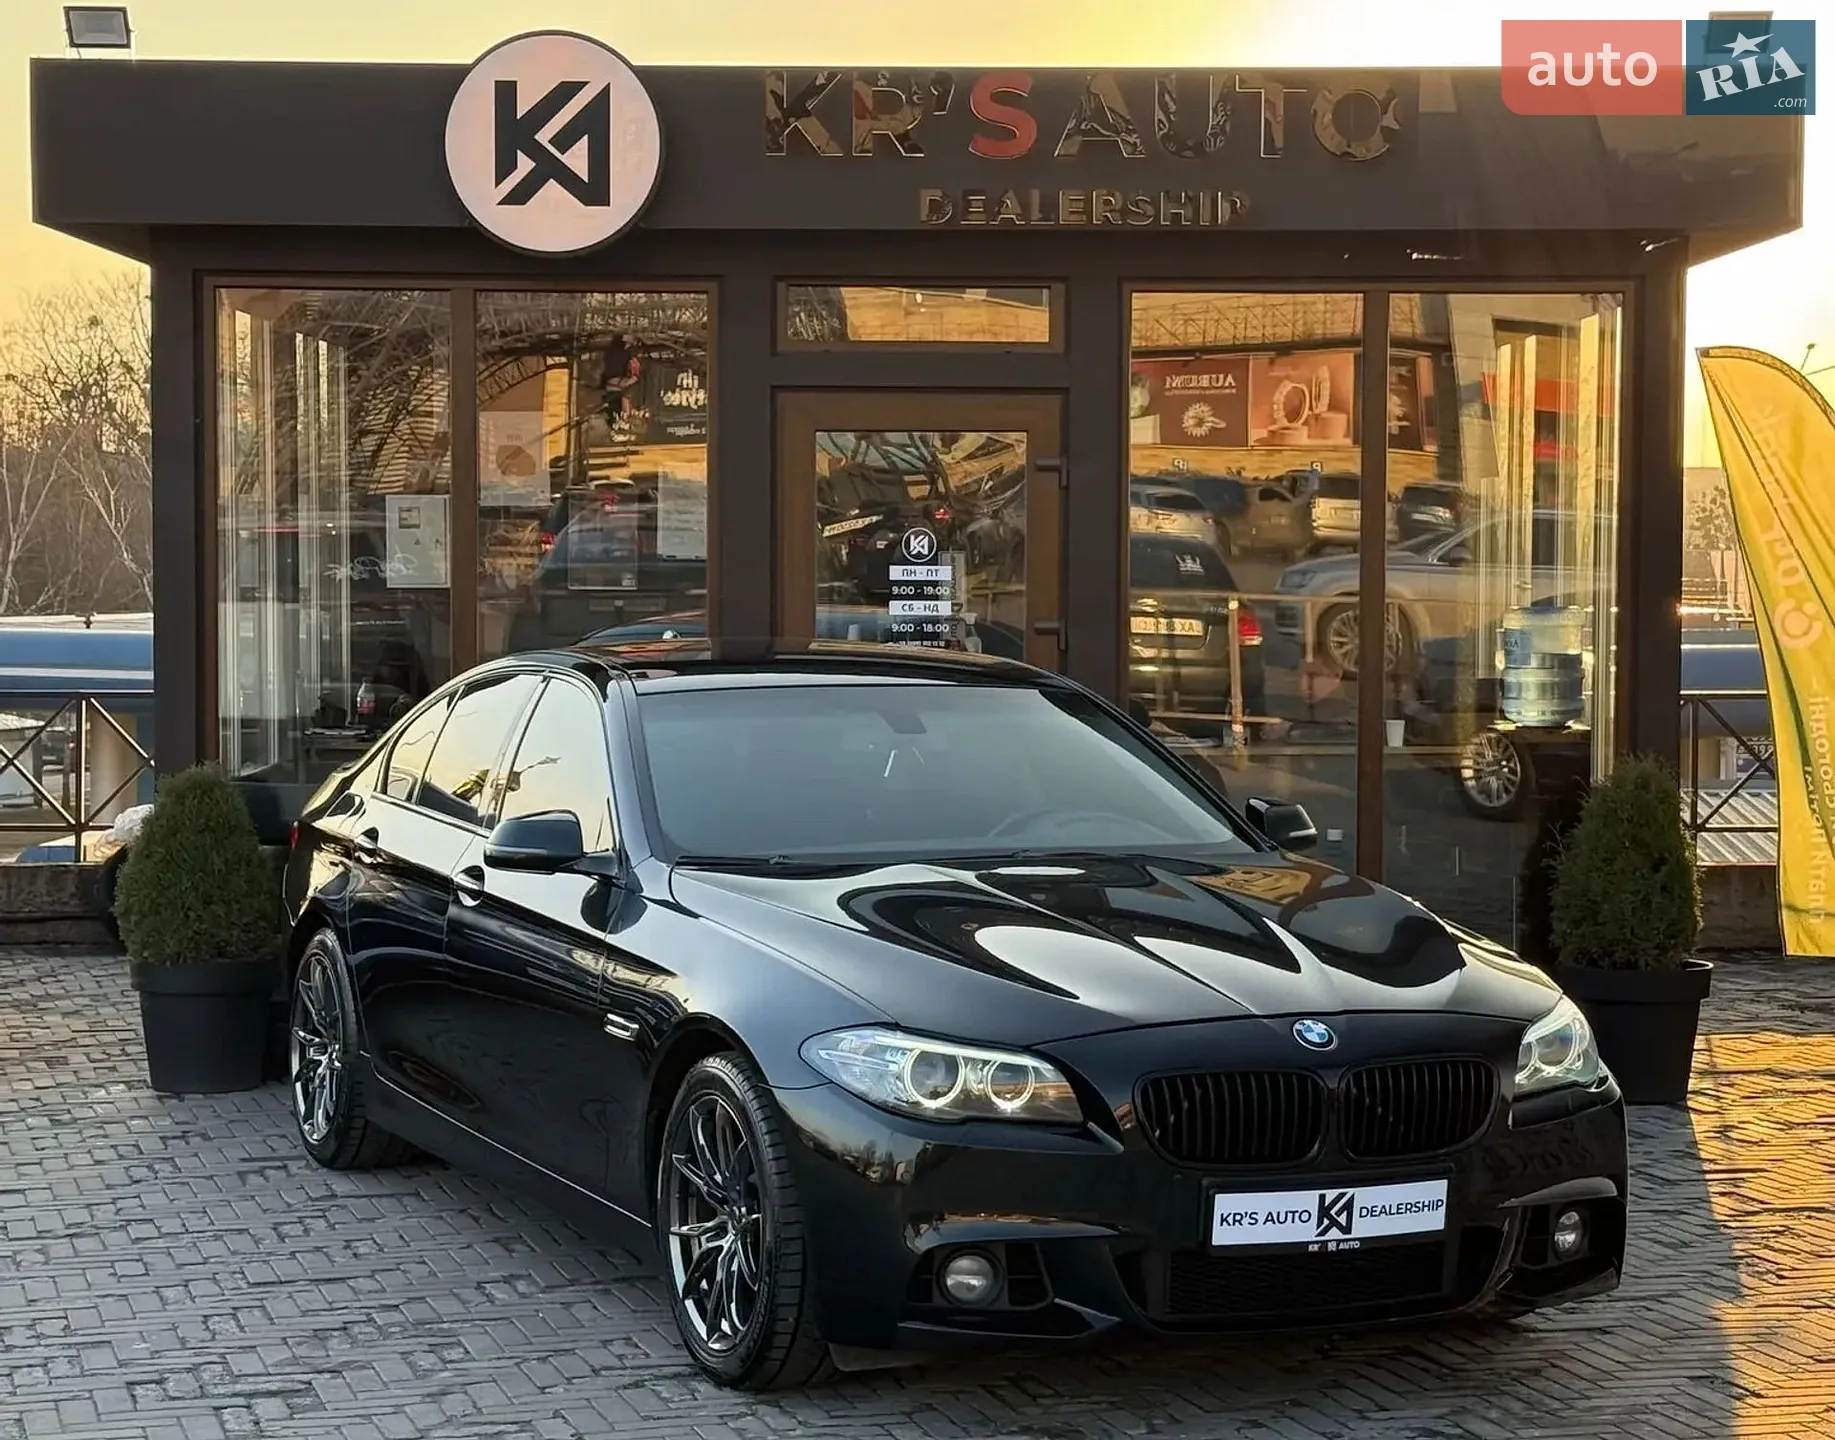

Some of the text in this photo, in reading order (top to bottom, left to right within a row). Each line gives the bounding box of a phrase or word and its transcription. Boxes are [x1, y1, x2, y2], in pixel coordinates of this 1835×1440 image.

[765, 72, 1398, 162] KR'S AUTO
[919, 188, 1250, 226] DEALERSHIP
[902, 569, 917, 577] ПН
[926, 569, 940, 577] ПТ
[891, 586, 915, 595] 9:00
[923, 586, 950, 595] 19:00
[902, 604, 914, 612] СБ
[923, 604, 940, 613] НД
[891, 623, 915, 632] 9:00
[922, 623, 950, 632] 18:00
[1219, 1210, 1259, 1227] KR'S
[1262, 1209, 1312, 1226] AUTO
[1358, 1198, 1444, 1219] DEALERSHIP
[1338, 1240, 1361, 1250] AUTO
